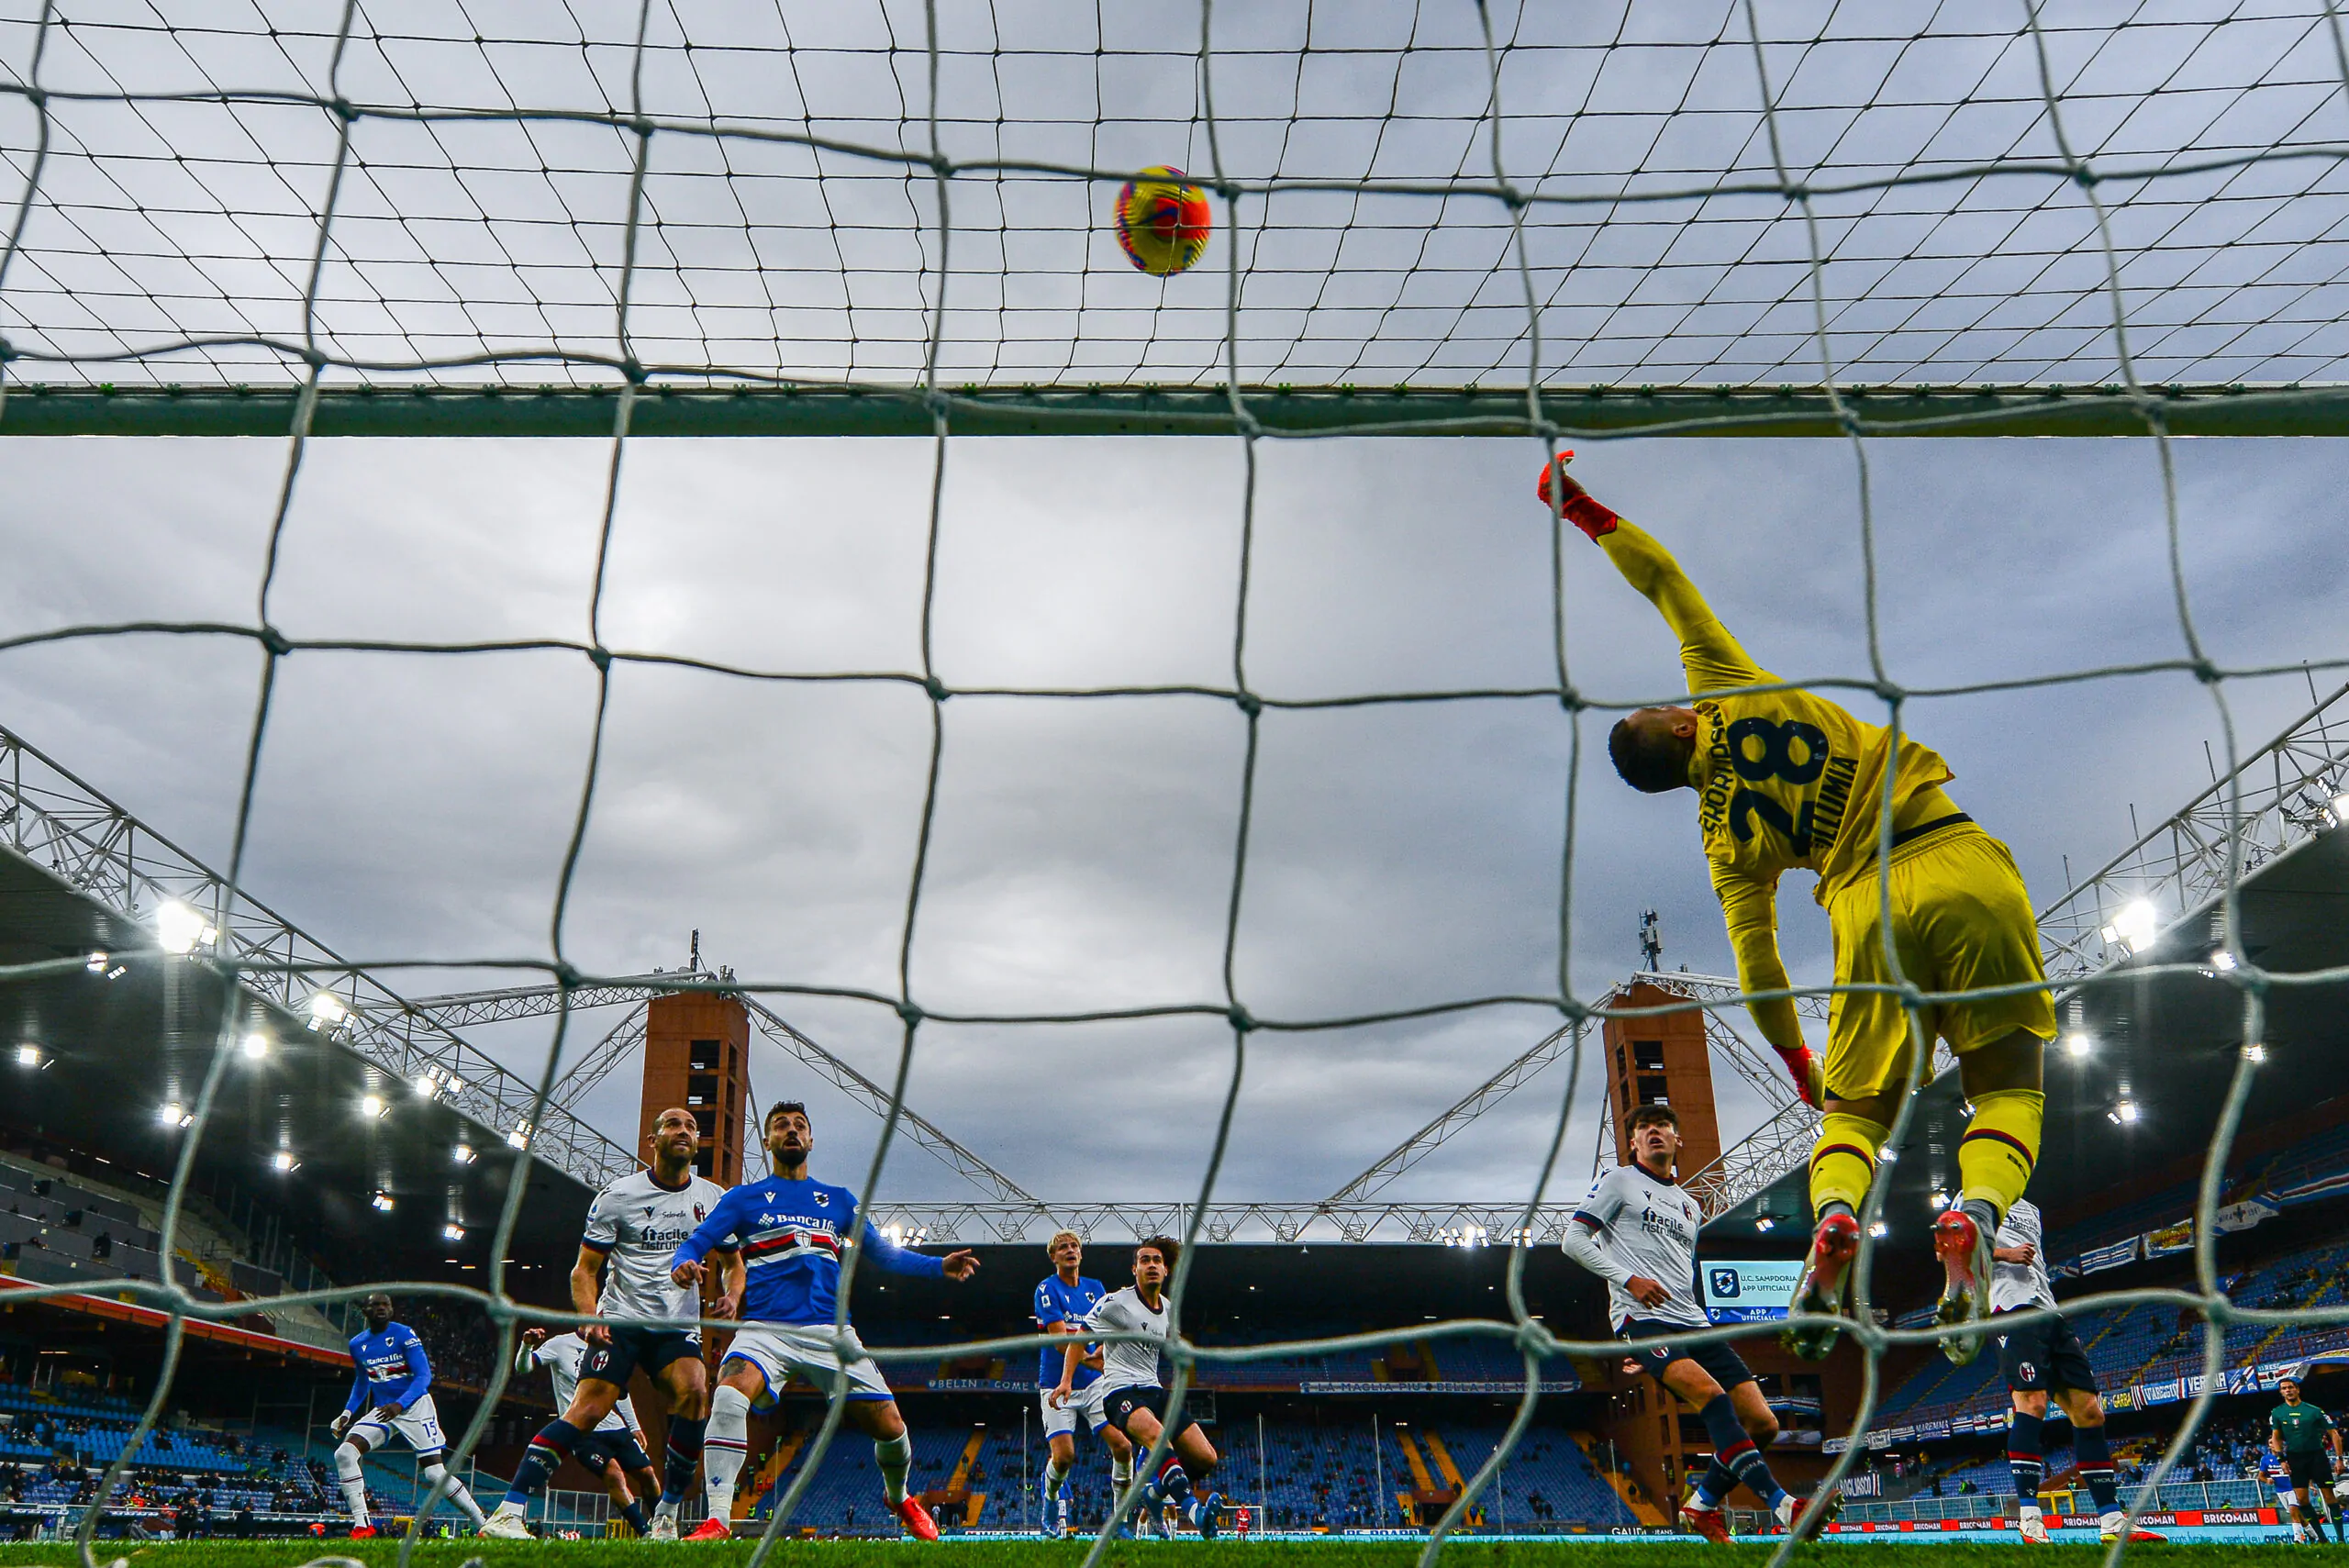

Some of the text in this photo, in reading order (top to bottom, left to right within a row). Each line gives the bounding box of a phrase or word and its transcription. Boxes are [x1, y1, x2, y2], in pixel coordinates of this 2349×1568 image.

[1728, 717, 1830, 858] 28
[776, 1214, 820, 1229] Banca
[938, 1379, 1029, 1390] BELIN COME
[1341, 1383, 1393, 1392] MAGLIA
[1436, 1383, 1479, 1392] BELLA
[1485, 1383, 1509, 1392] DEL
[1515, 1383, 1564, 1392] MNDO
[2188, 1373, 2227, 1392] VERNA
[422, 1418, 438, 1438] 15
[2134, 1515, 2176, 1526] RICOMAN
[2203, 1512, 2258, 1524] BRICOMAN
[1913, 1522, 1941, 1530] BRICOMAN
